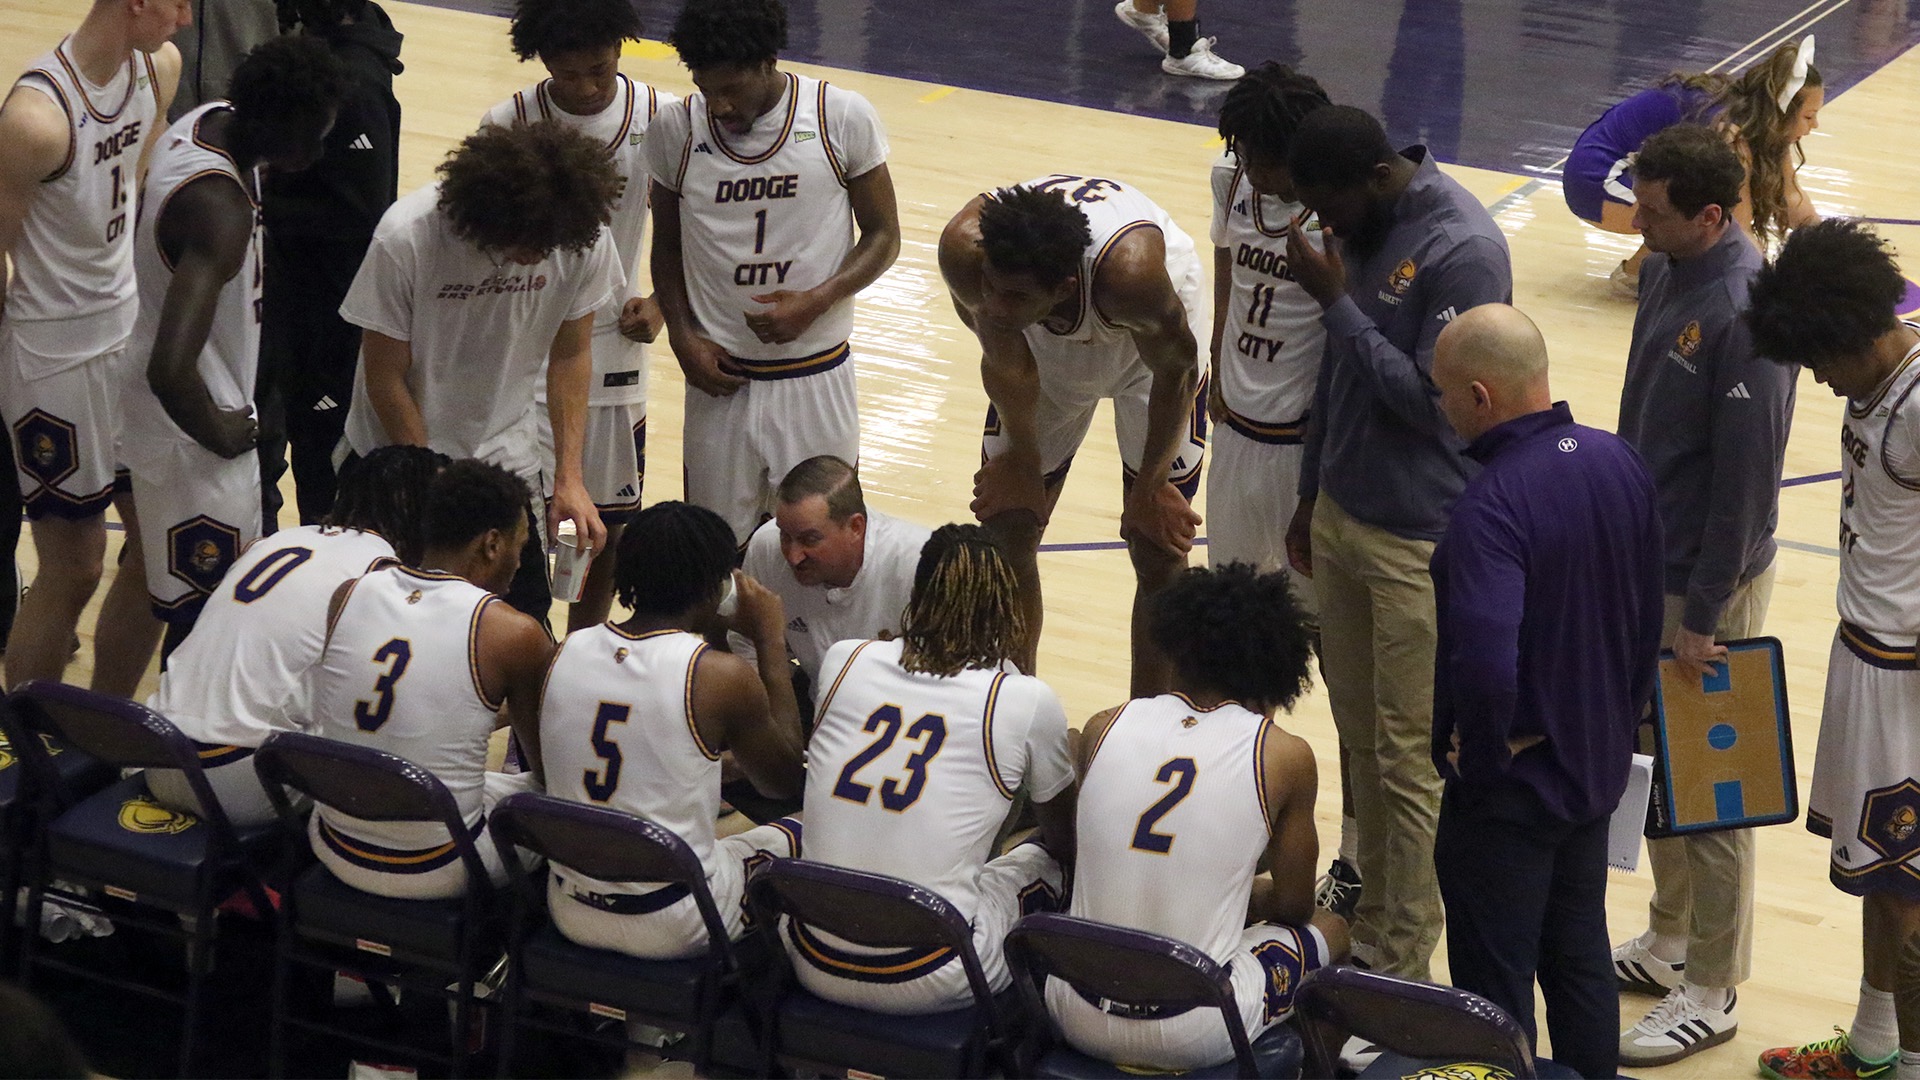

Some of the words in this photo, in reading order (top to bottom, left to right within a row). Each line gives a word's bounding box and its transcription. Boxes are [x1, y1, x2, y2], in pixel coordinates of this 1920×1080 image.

[715, 174, 799, 203] DODGE
[754, 208, 768, 255] 1
[733, 260, 793, 286] CITY
[1247, 282, 1275, 328] 11
[1238, 331, 1285, 363] CITY
[232, 545, 314, 605] 0
[352, 636, 414, 735] 3
[582, 701, 633, 803] 5
[831, 703, 949, 814] 23
[1129, 756, 1199, 857] 2
